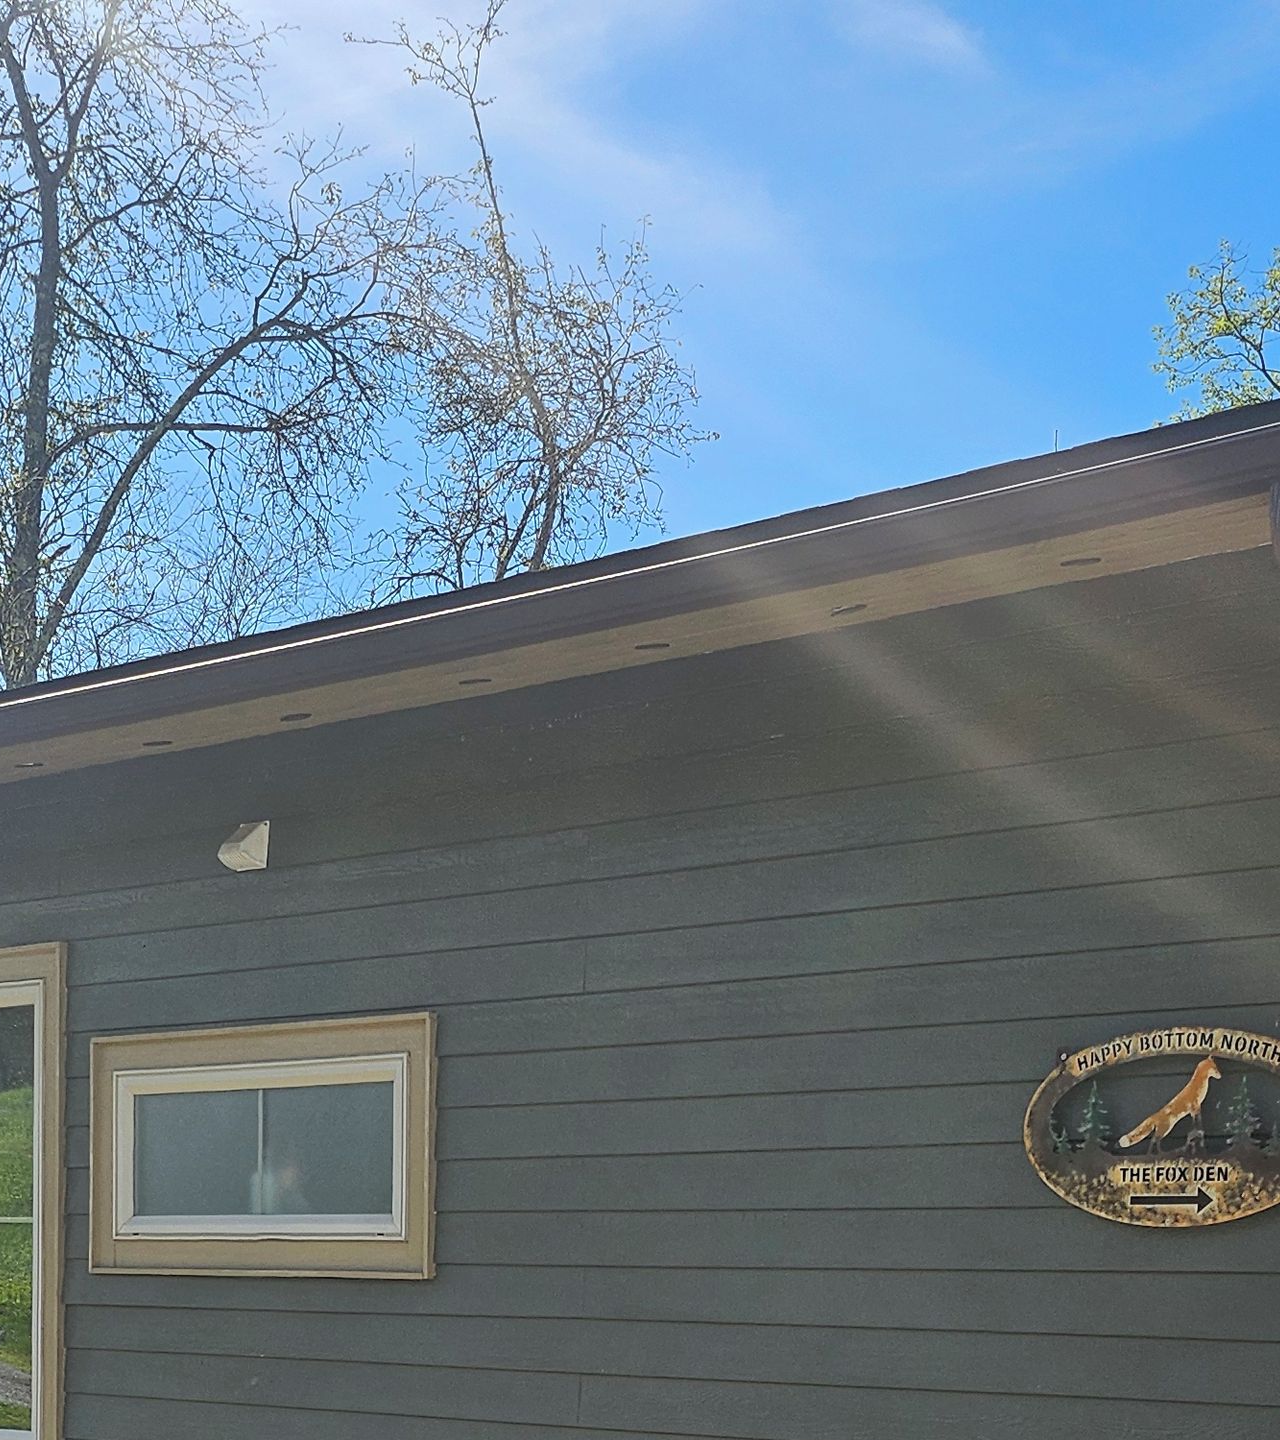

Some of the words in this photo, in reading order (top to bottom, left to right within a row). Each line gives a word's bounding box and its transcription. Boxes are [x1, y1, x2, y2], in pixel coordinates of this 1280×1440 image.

[1077, 1039, 1132, 1071] HAPPY
[1139, 1032, 1214, 1050] BOTTOM
[1120, 1167, 1151, 1183] THE
[1155, 1166, 1189, 1183] FOX
[1193, 1166, 1230, 1182] DEN
